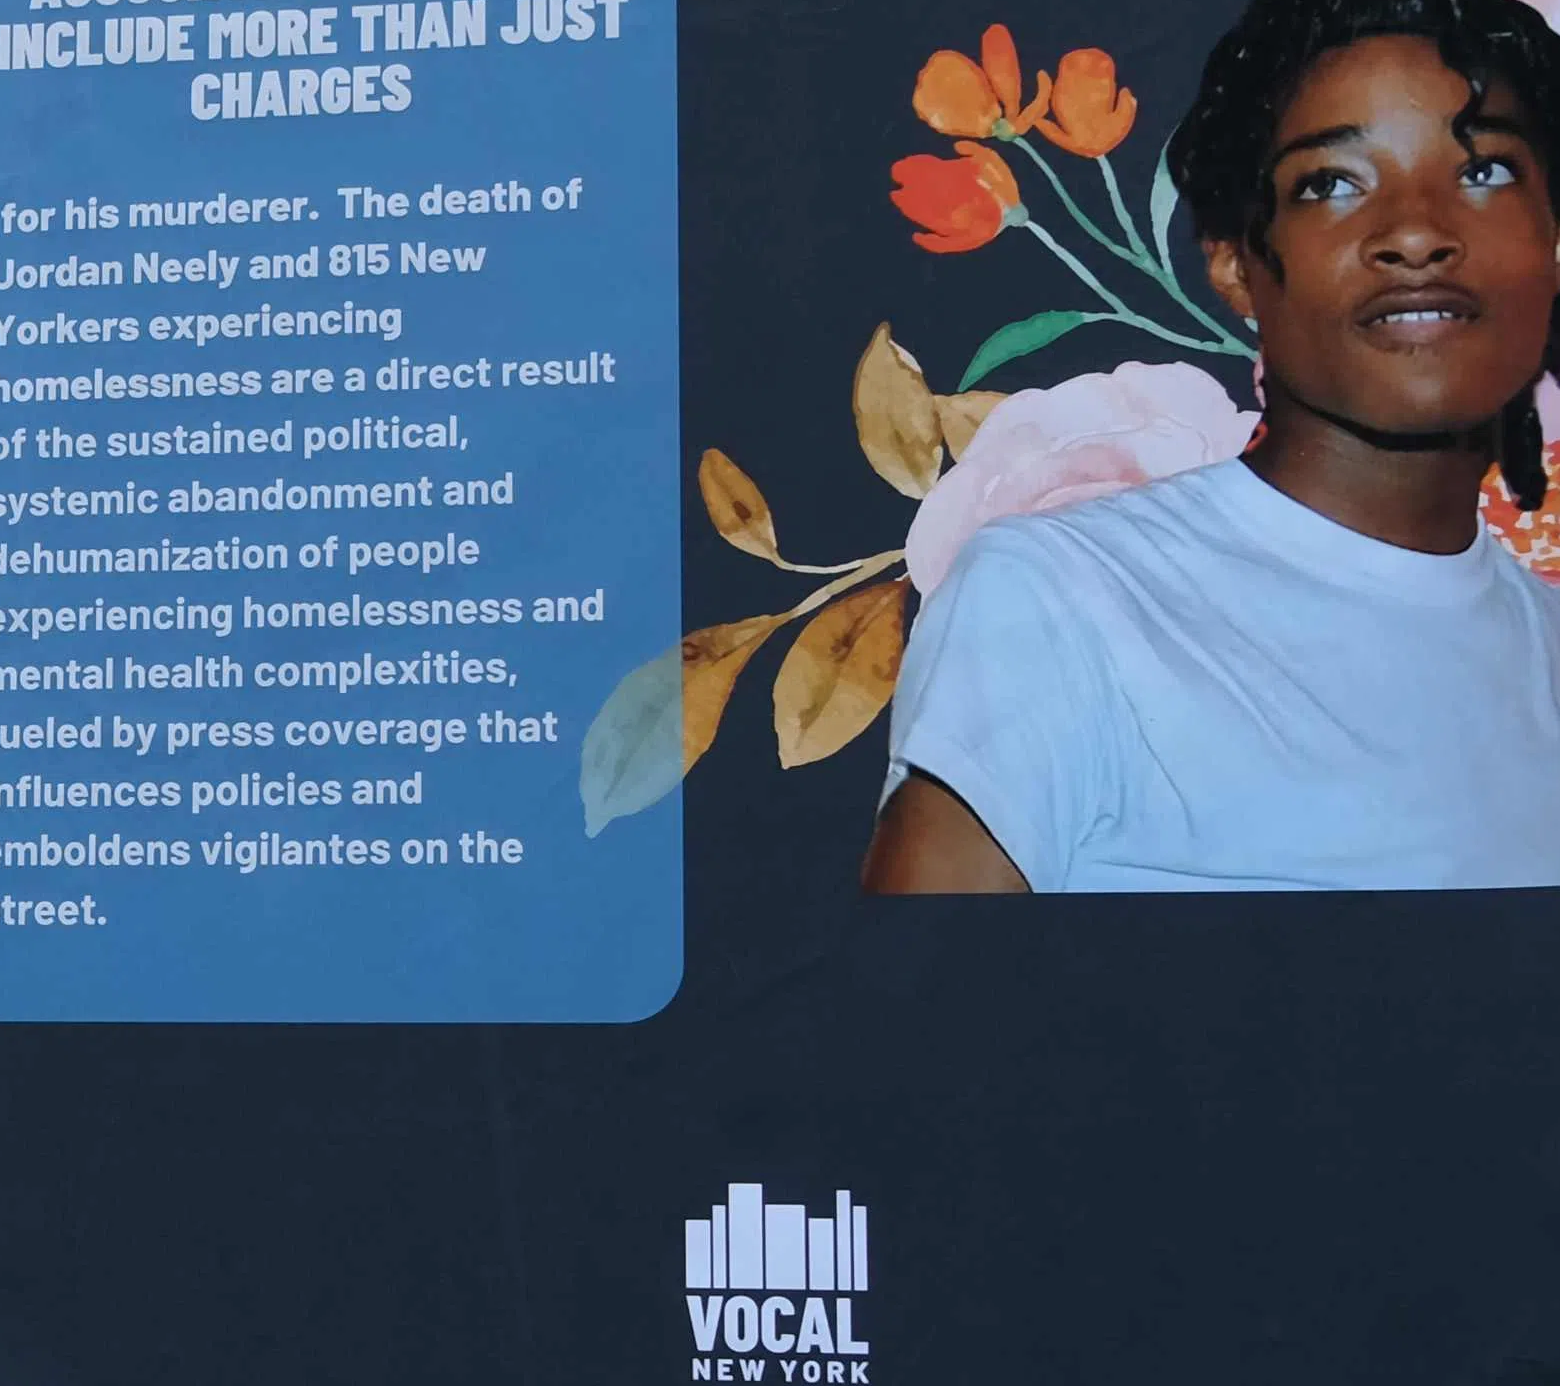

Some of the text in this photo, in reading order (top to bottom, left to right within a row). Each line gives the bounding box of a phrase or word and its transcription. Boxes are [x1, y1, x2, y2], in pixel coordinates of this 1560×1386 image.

[208, 6, 338, 60] MORE
[190, 63, 412, 121] CHARGES
[0, 177, 583, 234] for his murderer. The death of
[133, 249, 241, 290] Neely
[248, 245, 319, 280] and
[328, 243, 390, 277] 815
[400, 241, 487, 274] New
[148, 300, 402, 347] experiencing
[271, 368, 335, 394] are
[343, 367, 366, 392] a
[375, 356, 492, 391] direct
[502, 351, 616, 387] result
[35, 426, 97, 458] the
[107, 419, 293, 457] sustained
[304, 414, 468, 459] political,
[167, 476, 433, 513] abandonment
[443, 471, 513, 506] and
[298, 535, 339, 568] of
[349, 532, 480, 575] people
[243, 593, 523, 629] homelessness
[532, 588, 604, 623] and
[124, 655, 243, 689] health
[254, 649, 517, 694] complexities,
[112, 715, 157, 756] by
[167, 721, 275, 755] press
[284, 718, 467, 753] coverage
[477, 710, 558, 743] that
[191, 771, 342, 814] policies
[351, 771, 422, 805] and
[200, 831, 391, 874] vigilantes
[401, 839, 448, 865] on
[458, 830, 524, 864] the
[685, 1294, 869, 1355] VOCAL
[692, 1357, 869, 1384] NEW YORK
